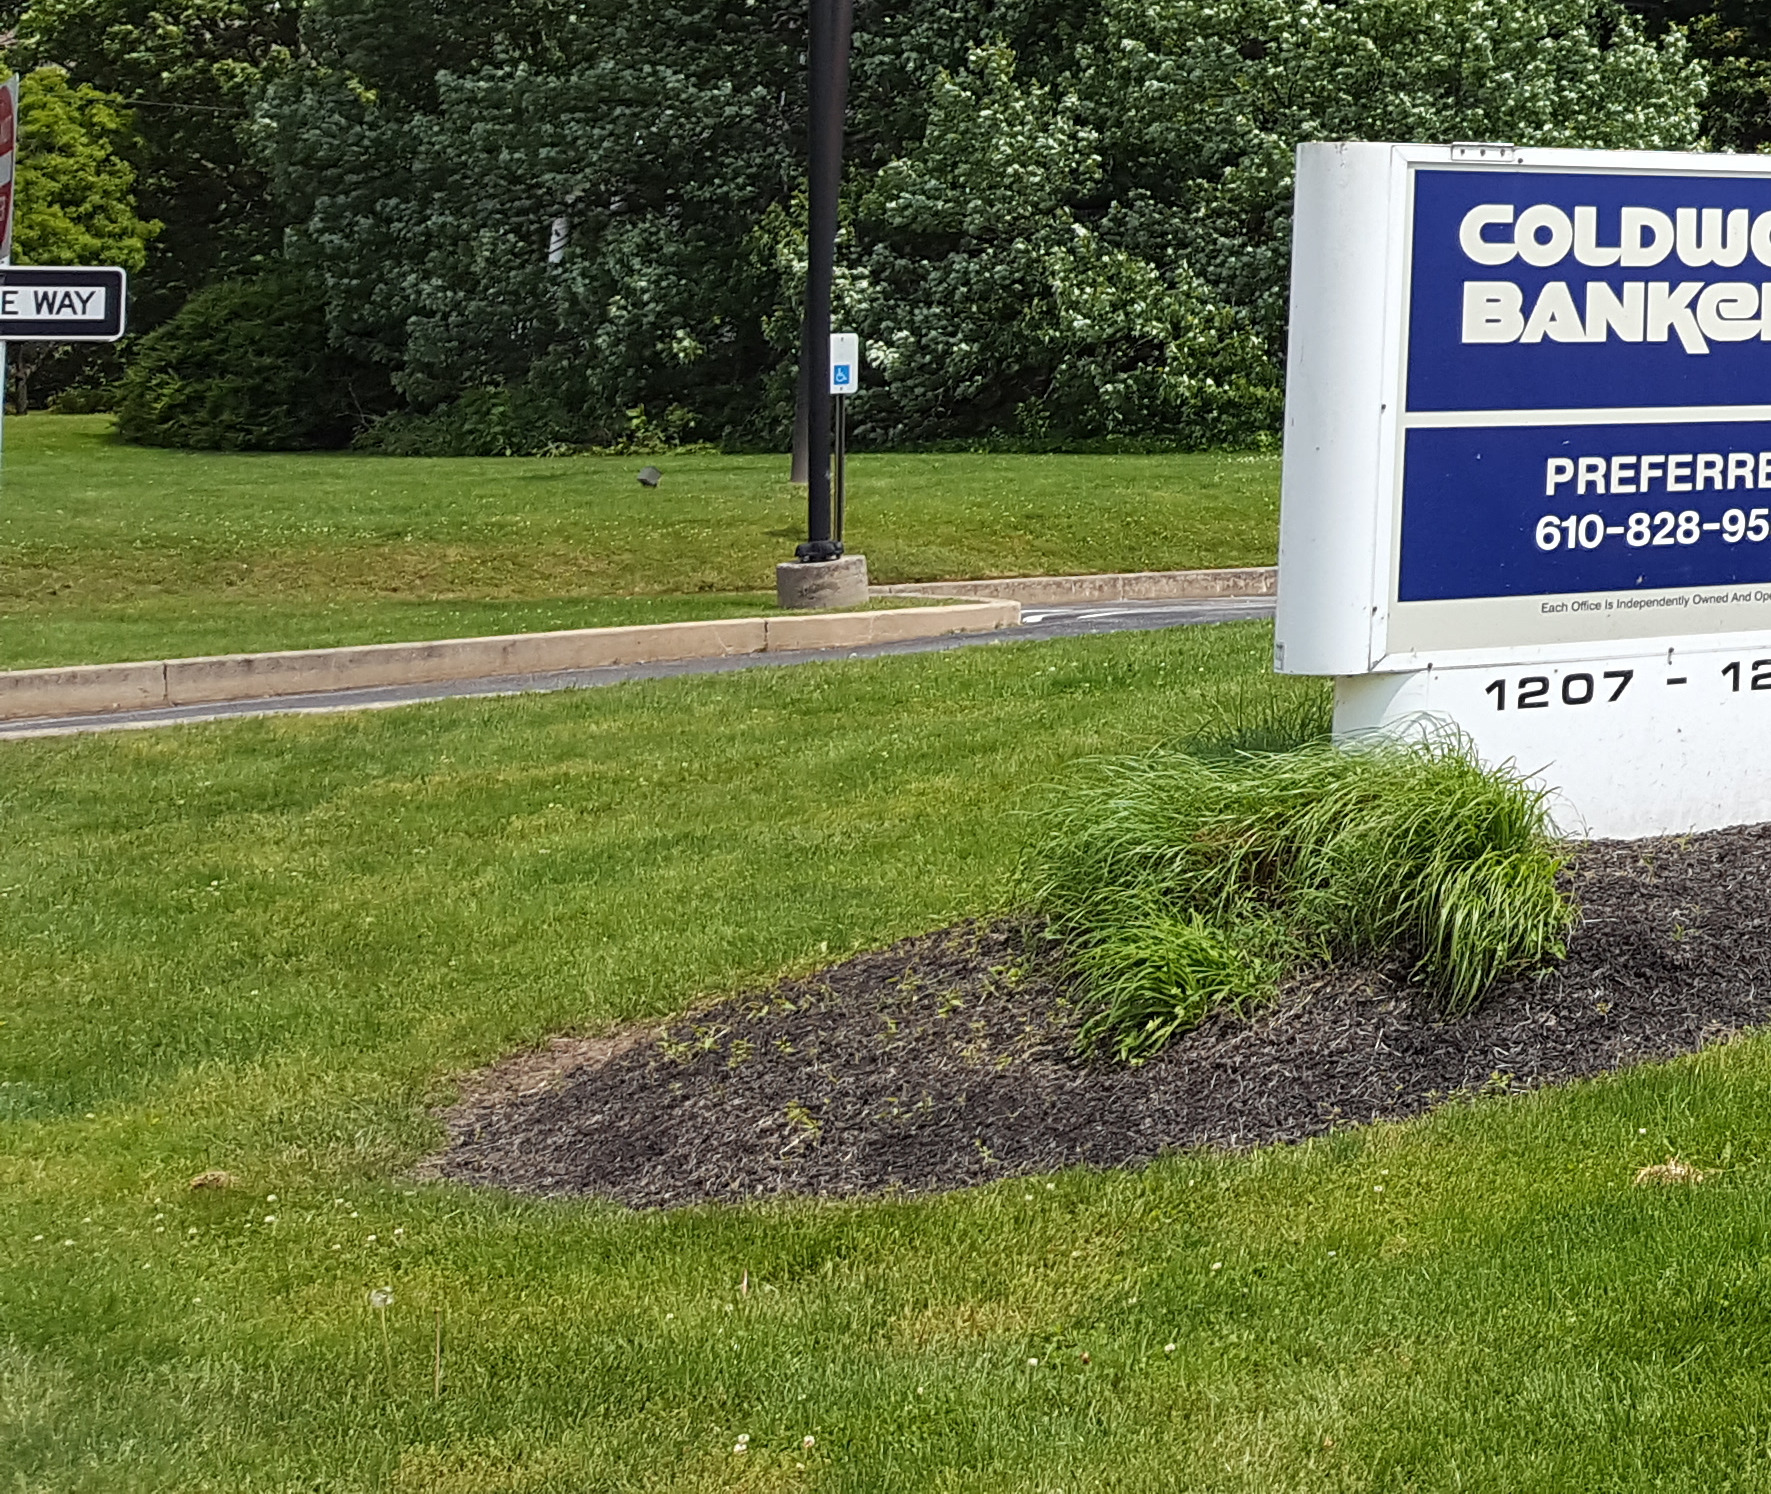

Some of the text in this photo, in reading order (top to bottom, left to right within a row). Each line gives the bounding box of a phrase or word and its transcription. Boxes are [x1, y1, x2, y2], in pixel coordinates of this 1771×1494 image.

[33, 290, 97, 316] WAY
[1541, 602, 1568, 613] Each
[1571, 600, 1602, 612] Office
[1604, 598, 1614, 610] Is
[1616, 595, 1691, 610] Independently
[1692, 592, 1729, 605] Owned
[1731, 591, 1752, 603] And
[1485, 670, 1635, 711] 1207
